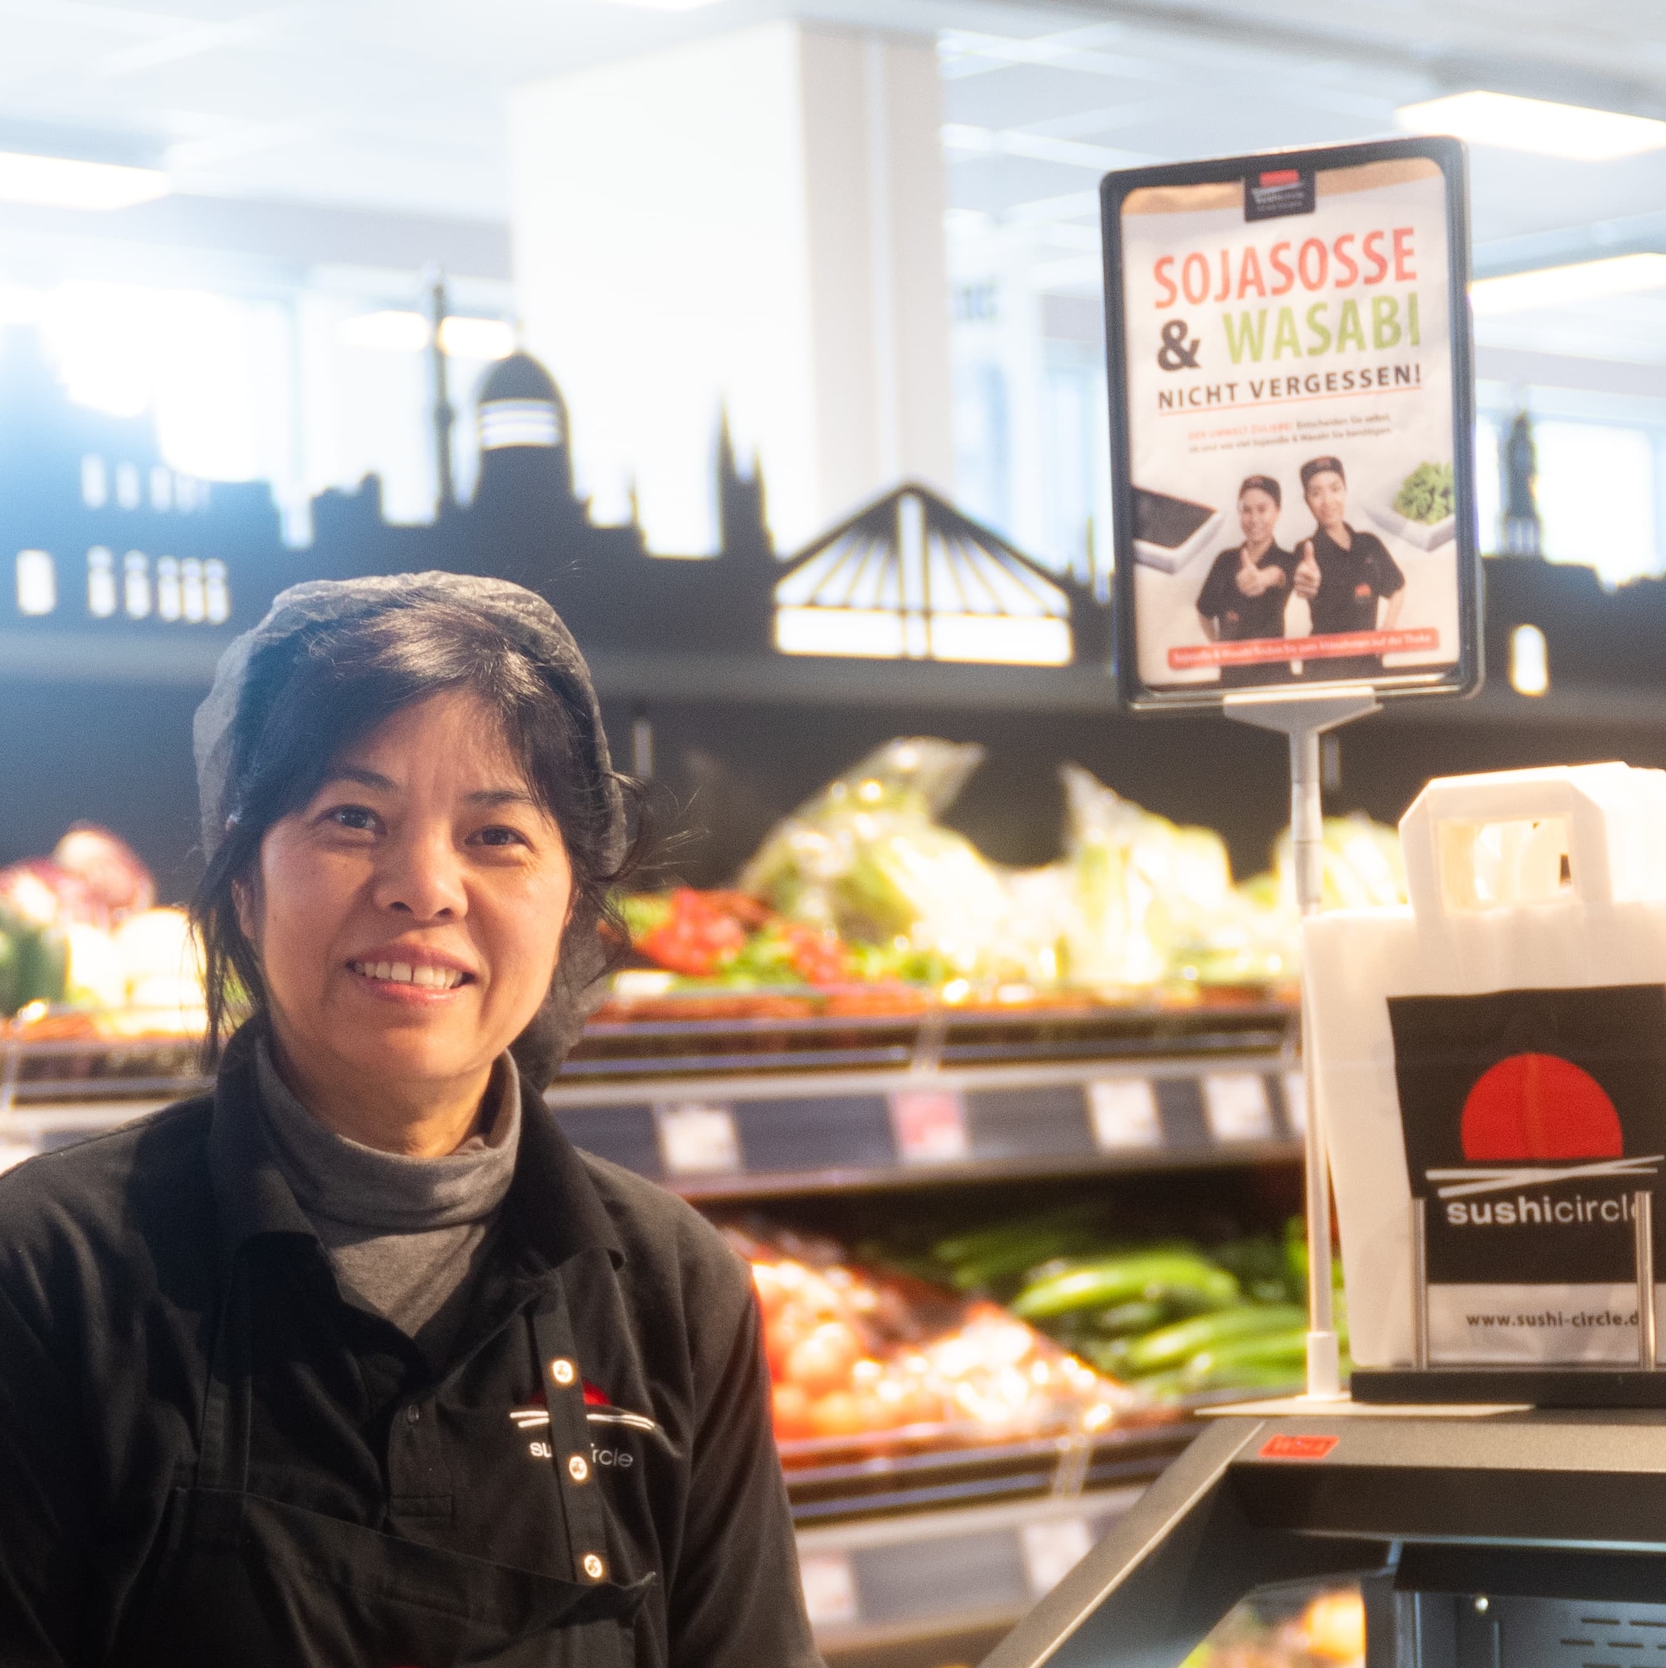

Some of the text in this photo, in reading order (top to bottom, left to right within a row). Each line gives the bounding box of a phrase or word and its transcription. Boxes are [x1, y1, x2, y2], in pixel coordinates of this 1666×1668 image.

[1153, 227, 1417, 309] SOJASOSSE
[1158, 291, 1421, 371] & WASABI
[1158, 364, 1422, 410] NICHT VERGESSEN!
